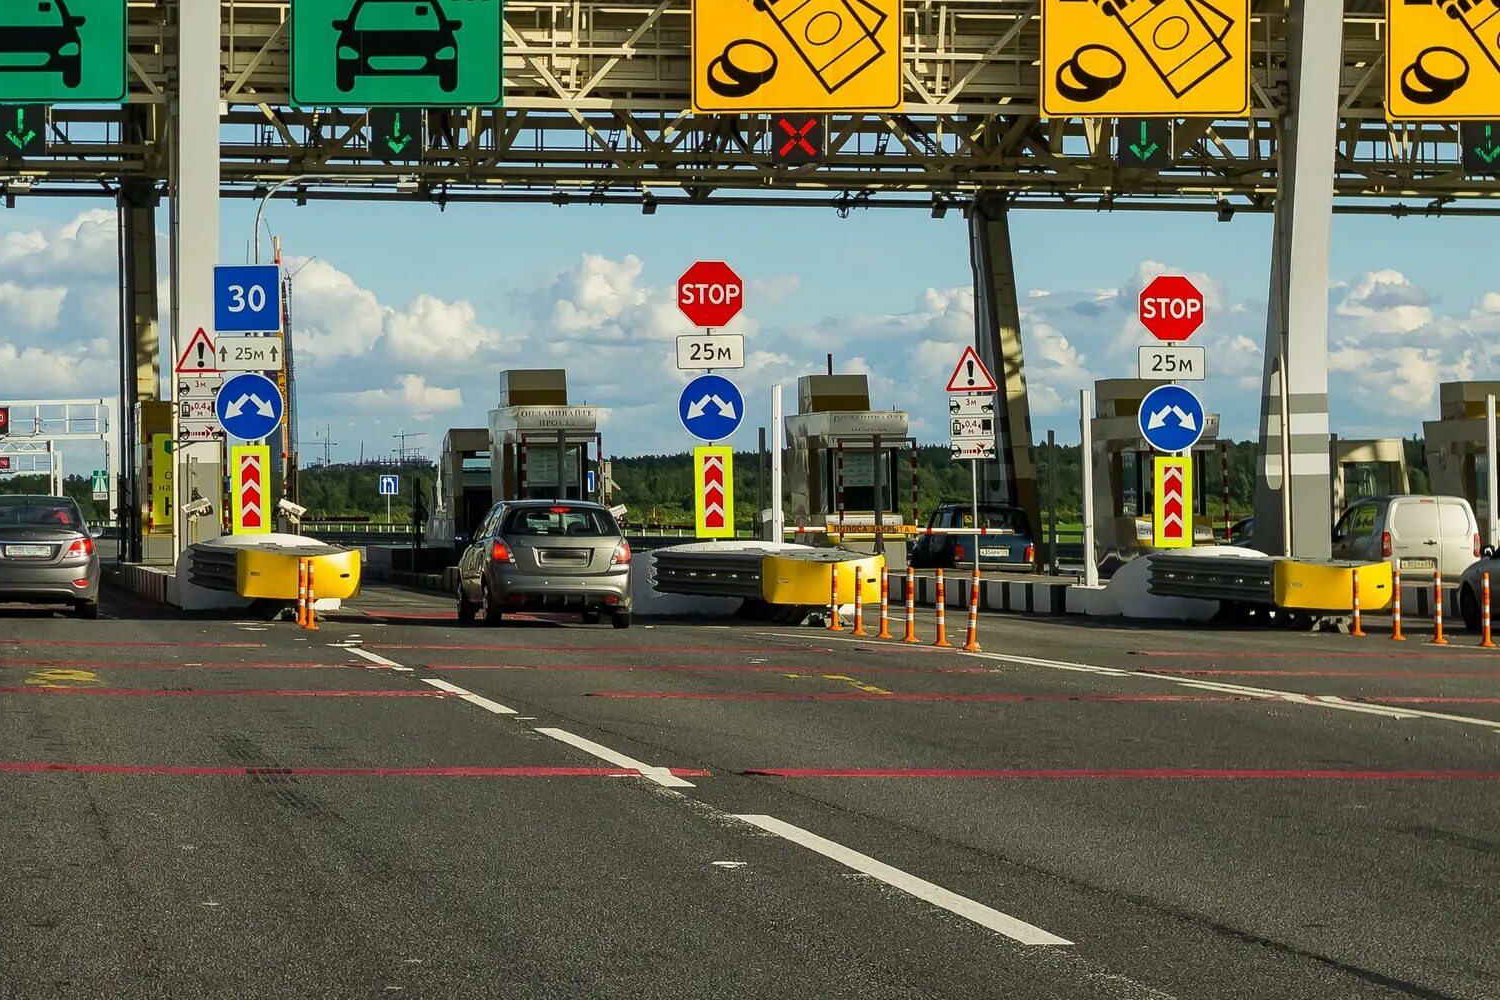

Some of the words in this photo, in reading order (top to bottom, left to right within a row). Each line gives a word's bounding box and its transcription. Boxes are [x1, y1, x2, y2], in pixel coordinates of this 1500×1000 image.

[227, 284, 266, 312] 30
[681, 283, 740, 305] STOP
[1143, 298, 1201, 319] STOP
[235, 347, 265, 361] 25м
[690, 343, 732, 361] 25м
[1151, 354, 1193, 372] 25м
[965, 420, 977, 428] 0,4
[834, 525, 868, 533] ПОЛОСА
[870, 525, 910, 533] ЗАКРЫТА
